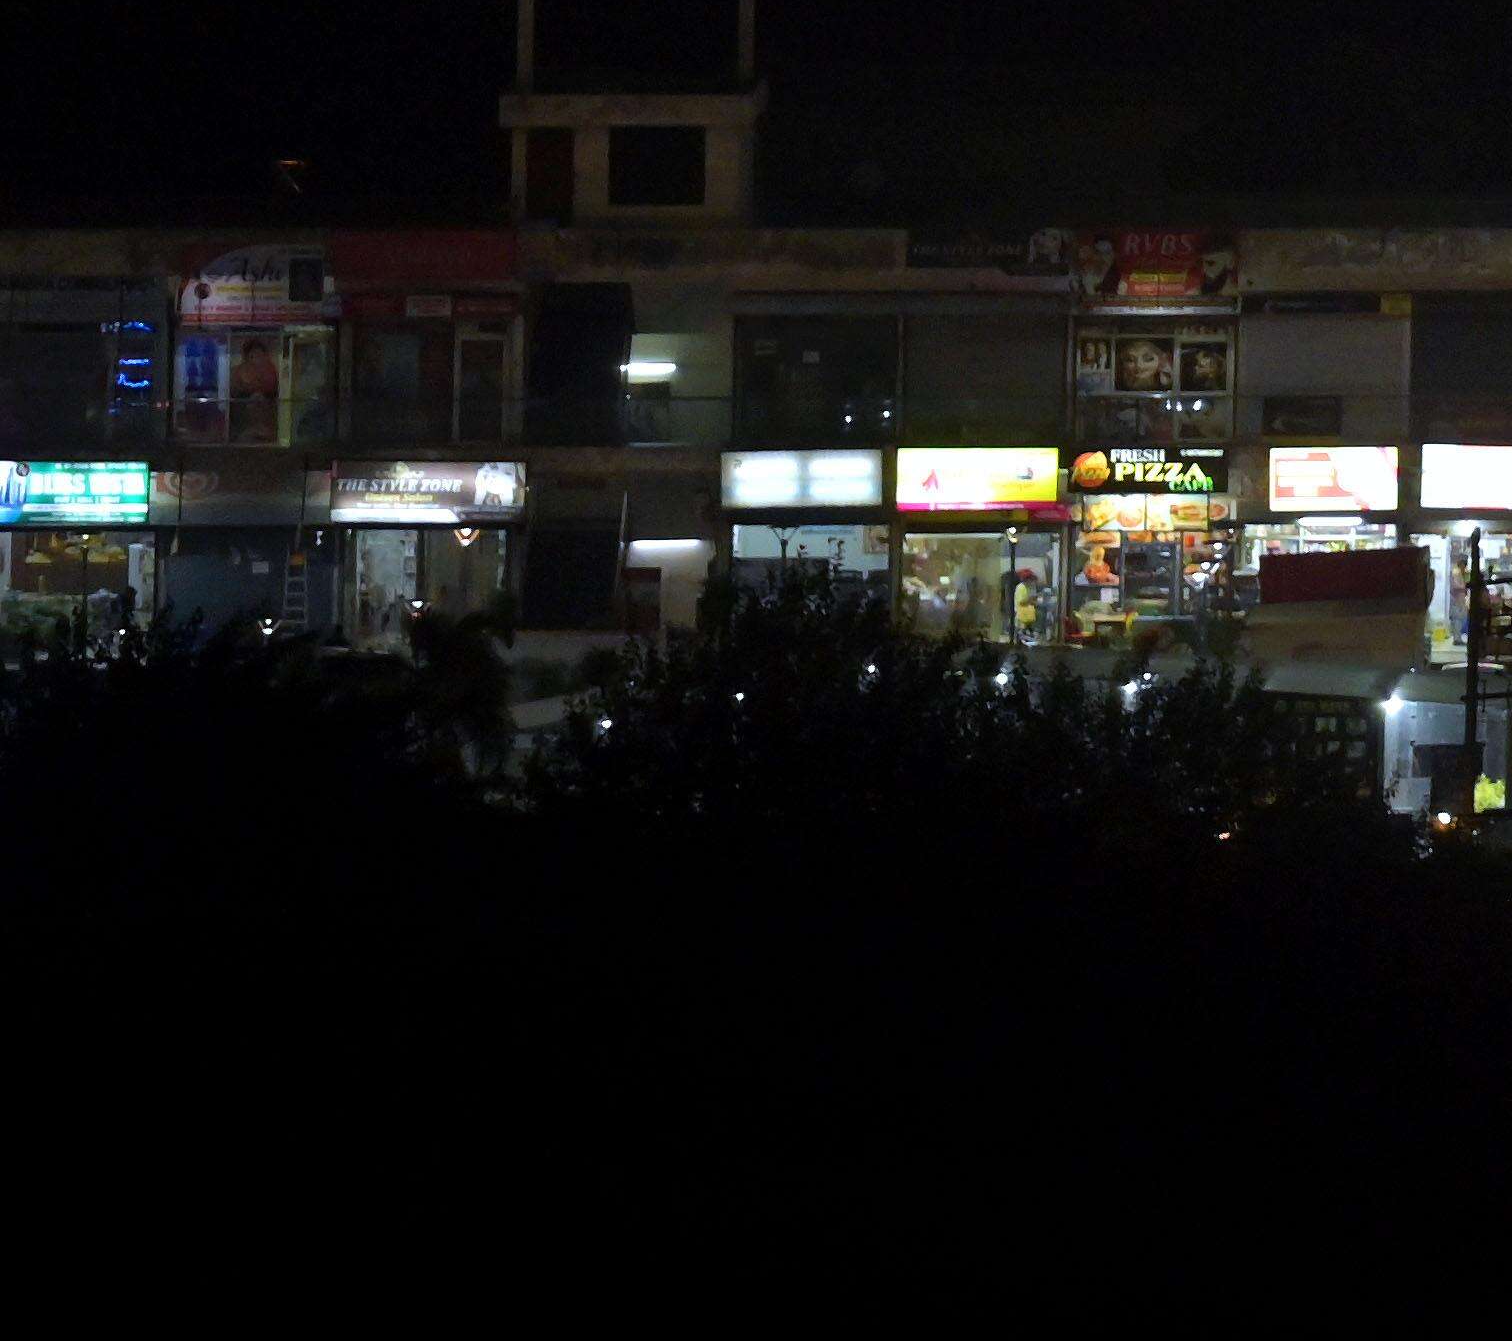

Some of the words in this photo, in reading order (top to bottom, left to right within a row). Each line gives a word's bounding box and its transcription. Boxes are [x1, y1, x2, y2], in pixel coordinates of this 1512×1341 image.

[1110, 449, 1166, 463] FRESH
[1114, 462, 1206, 482] PIZZA
[337, 479, 367, 492] THE
[370, 479, 417, 492] STYLE
